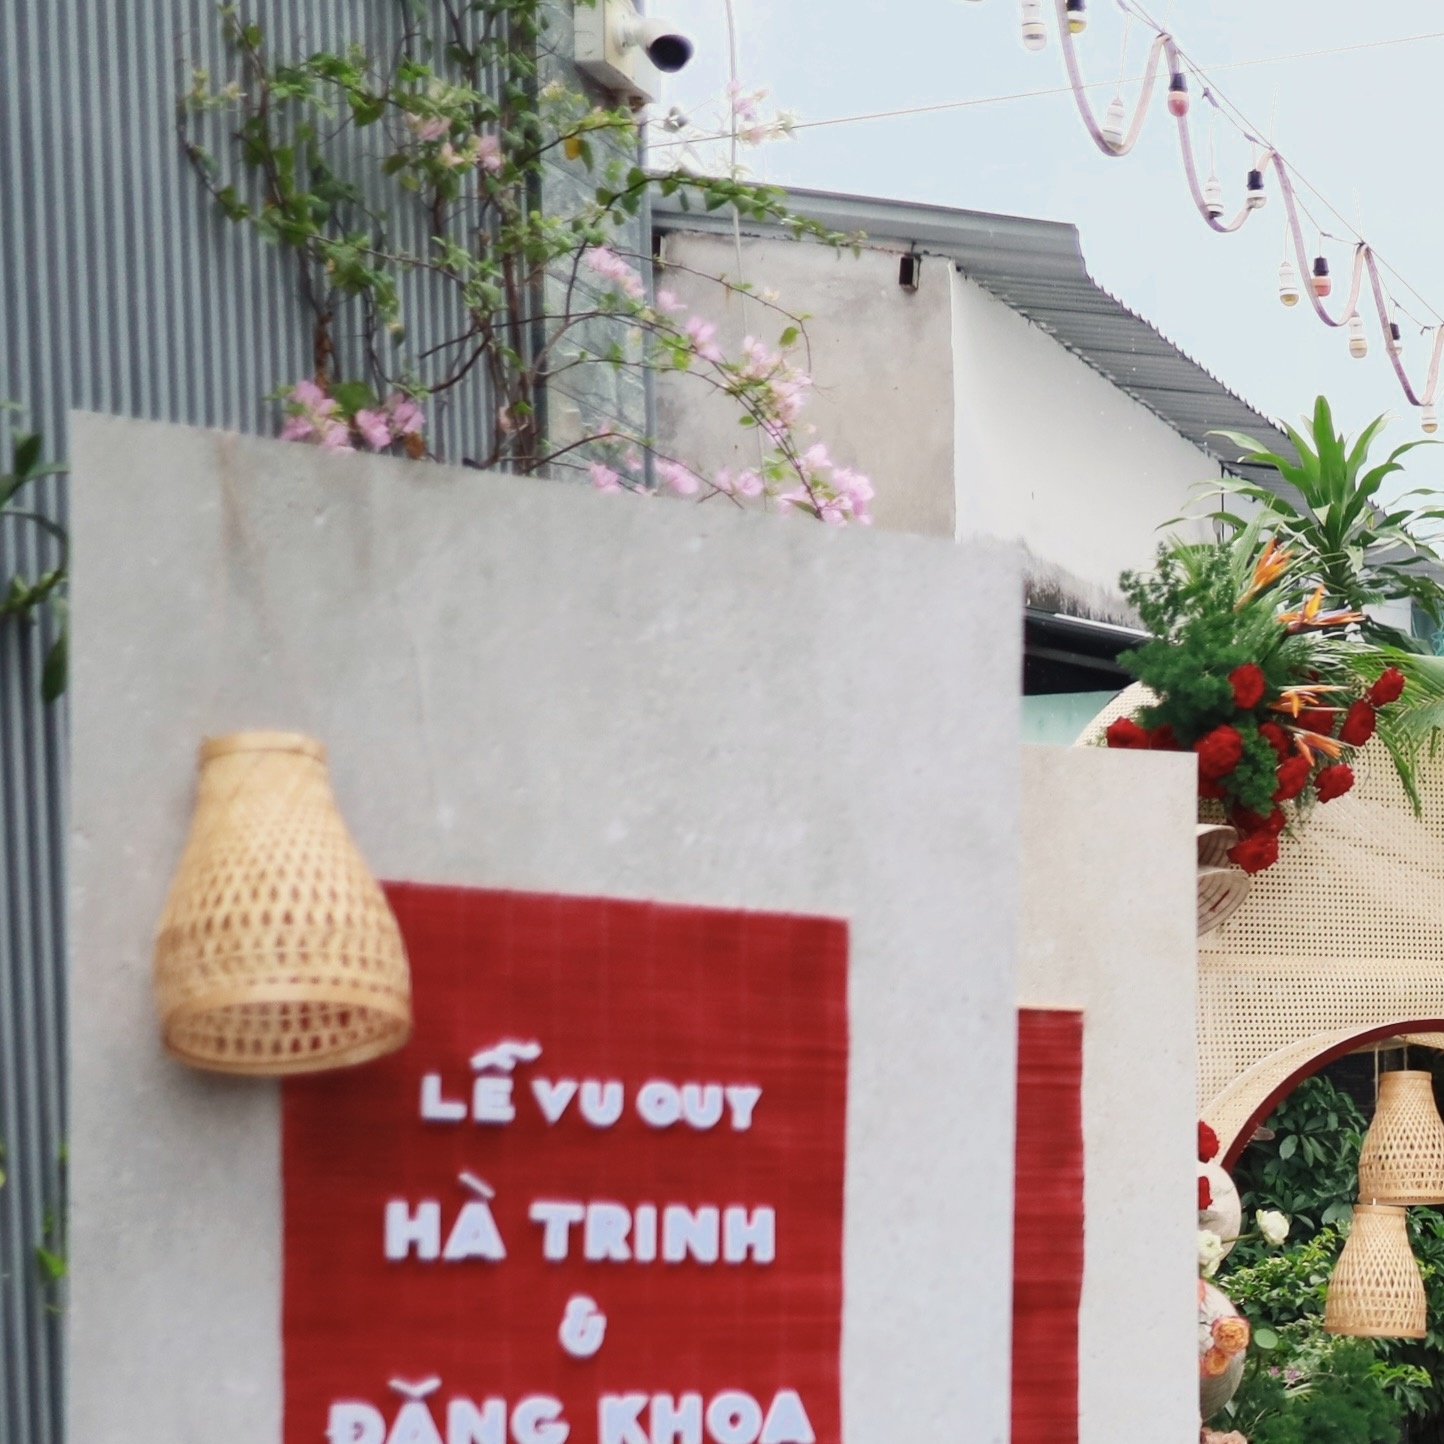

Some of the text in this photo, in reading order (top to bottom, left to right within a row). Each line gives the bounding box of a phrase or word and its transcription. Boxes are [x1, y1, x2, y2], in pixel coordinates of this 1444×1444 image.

[531, 1078, 624, 1128] VU
[384, 1171, 775, 1264] HÀ TRINH
[558, 1295, 606, 1357] &
